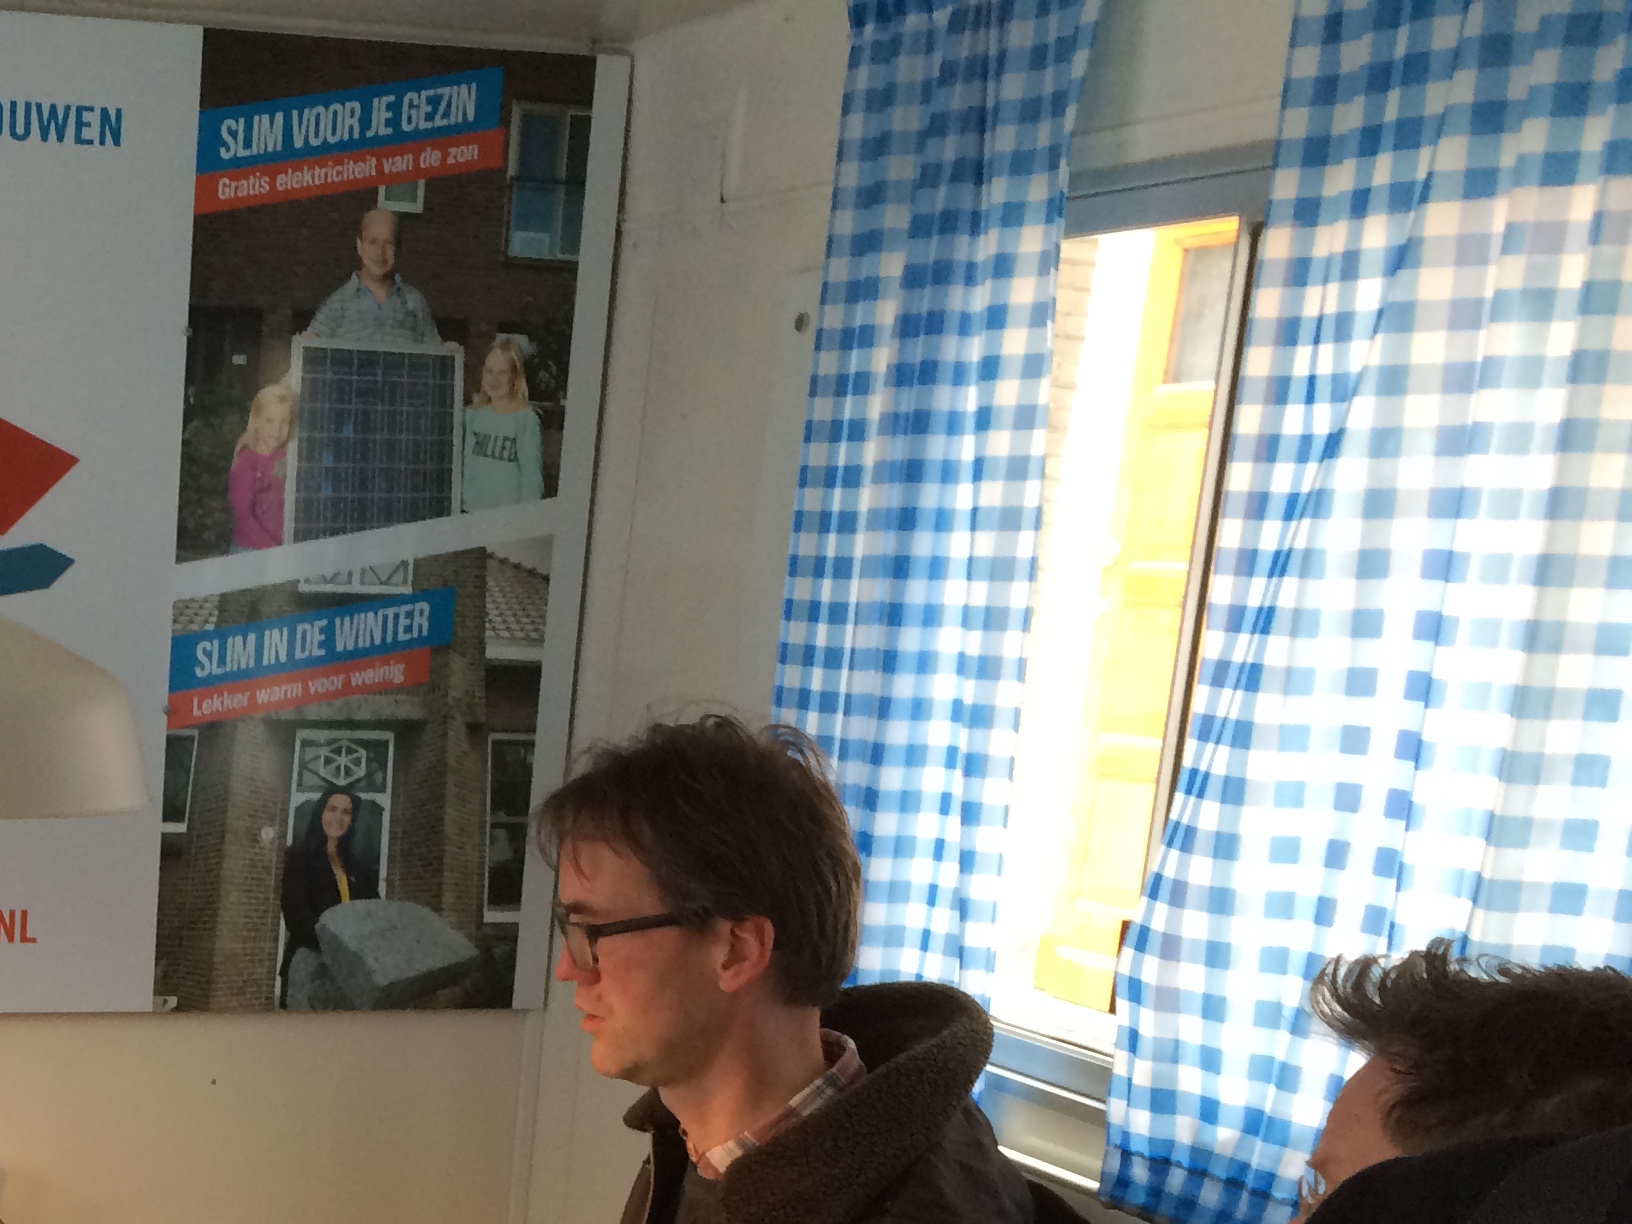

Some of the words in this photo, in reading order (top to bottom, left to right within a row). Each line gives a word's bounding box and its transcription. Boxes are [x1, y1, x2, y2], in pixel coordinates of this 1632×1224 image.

[219, 112, 283, 160] SLIM
[291, 101, 361, 149] VOOR
[365, 95, 395, 138] JE
[401, 82, 478, 132] GEZIN
[218, 173, 269, 200] Gratis
[275, 155, 377, 190] elektriciteit
[382, 152, 413, 175] van
[419, 146, 441, 168] de
[446, 143, 479, 165] zon
[194, 632, 255, 678] SLIM
[262, 627, 288, 665] IN
[294, 618, 328, 660] DE
[335, 602, 430, 653] WINTER
[192, 690, 249, 717] Lekker
[256, 680, 302, 704] warm
[308, 675, 343, 695] voor
[350, 660, 405, 686] weinig
